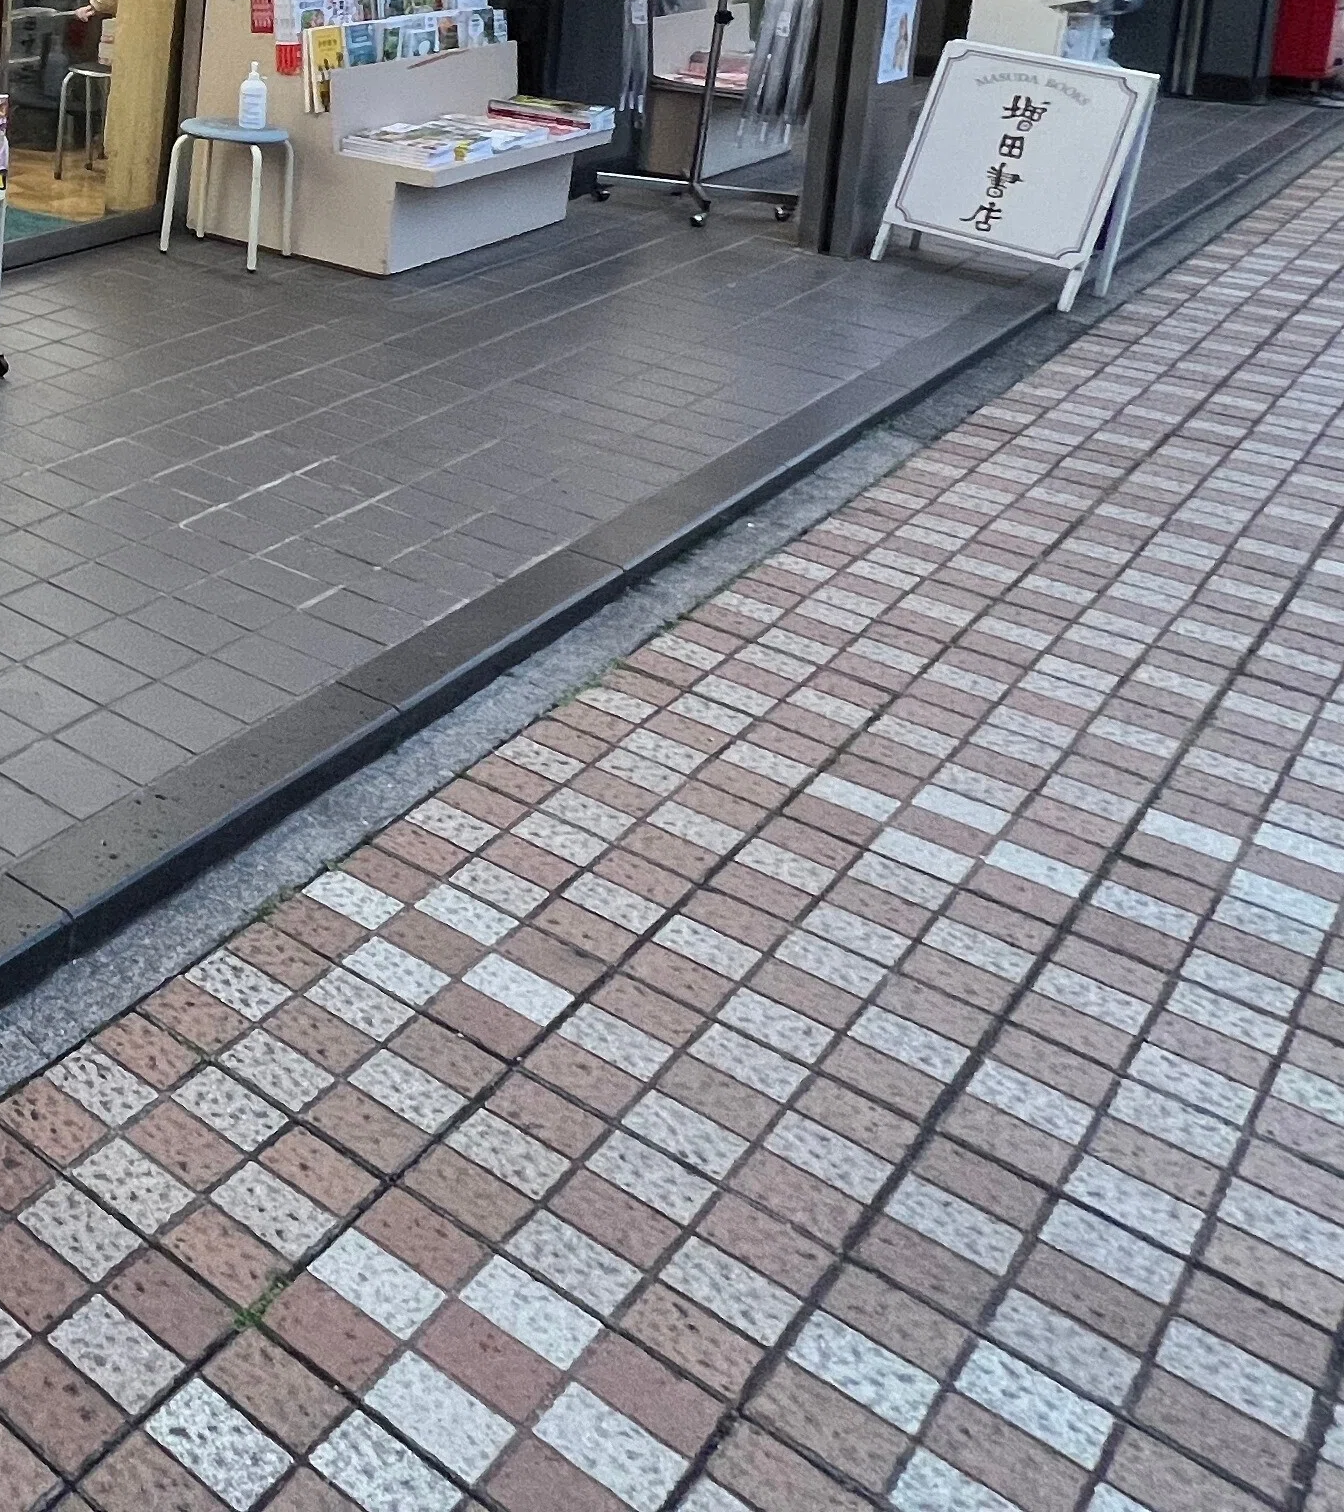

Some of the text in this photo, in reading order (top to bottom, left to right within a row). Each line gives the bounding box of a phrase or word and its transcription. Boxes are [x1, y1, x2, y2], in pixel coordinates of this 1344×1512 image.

[975, 72, 1039, 86] MASUDA
[959, 94, 1050, 233] 増田書店
